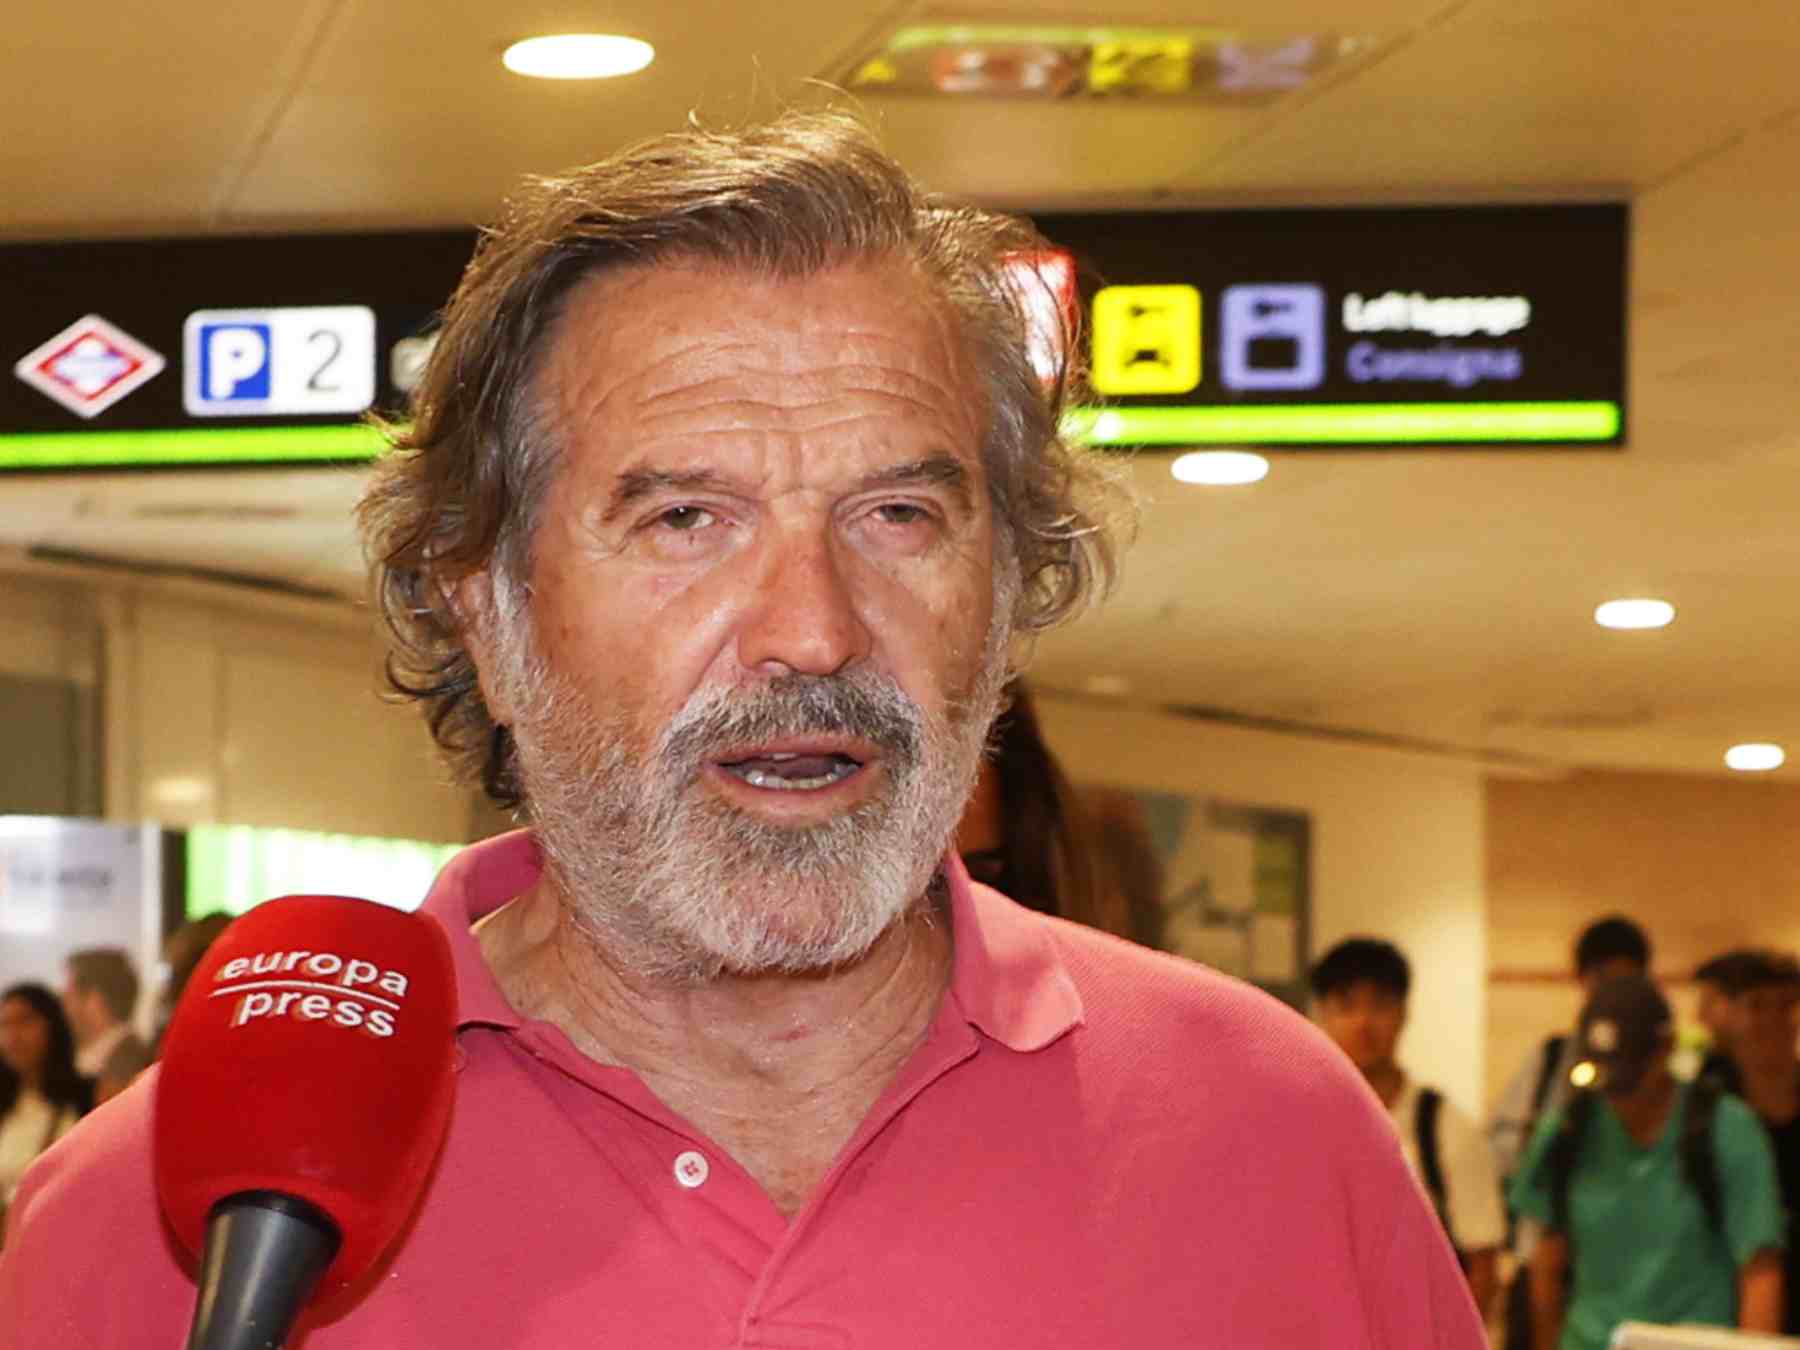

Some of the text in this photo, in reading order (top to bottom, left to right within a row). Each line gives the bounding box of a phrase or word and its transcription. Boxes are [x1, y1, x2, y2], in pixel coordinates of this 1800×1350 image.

[209, 327, 344, 400] P 2
[220, 950, 409, 998] europa
[236, 991, 397, 1038] press
